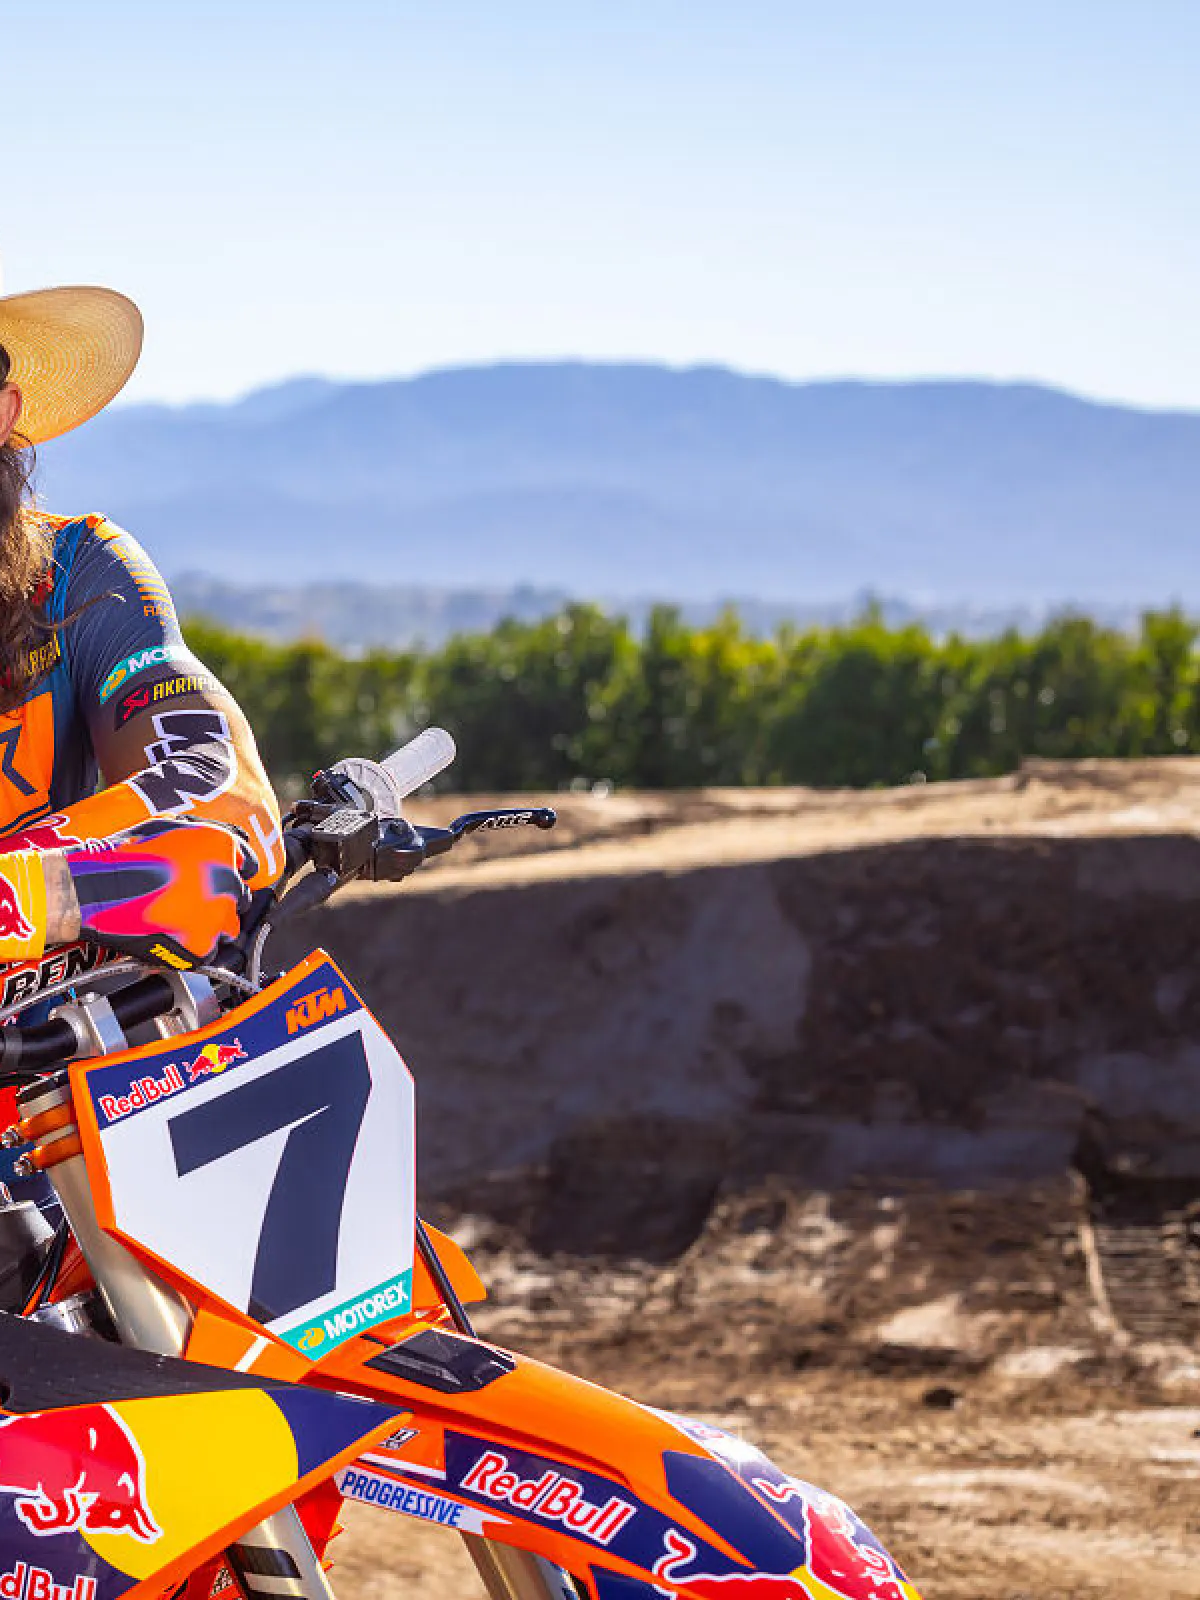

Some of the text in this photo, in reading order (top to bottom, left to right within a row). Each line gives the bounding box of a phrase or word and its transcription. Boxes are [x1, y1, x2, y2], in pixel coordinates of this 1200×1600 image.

[286, 985, 348, 1036] KTM
[99, 1064, 184, 1122] Red Bull
[167, 1029, 373, 1325] 7
[322, 1283, 410, 1340] MOTOREX
[339, 1470, 465, 1527] PROGRESSIVE
[459, 1448, 639, 1548] Red Bull
[28, 1565, 99, 1600] Bull
